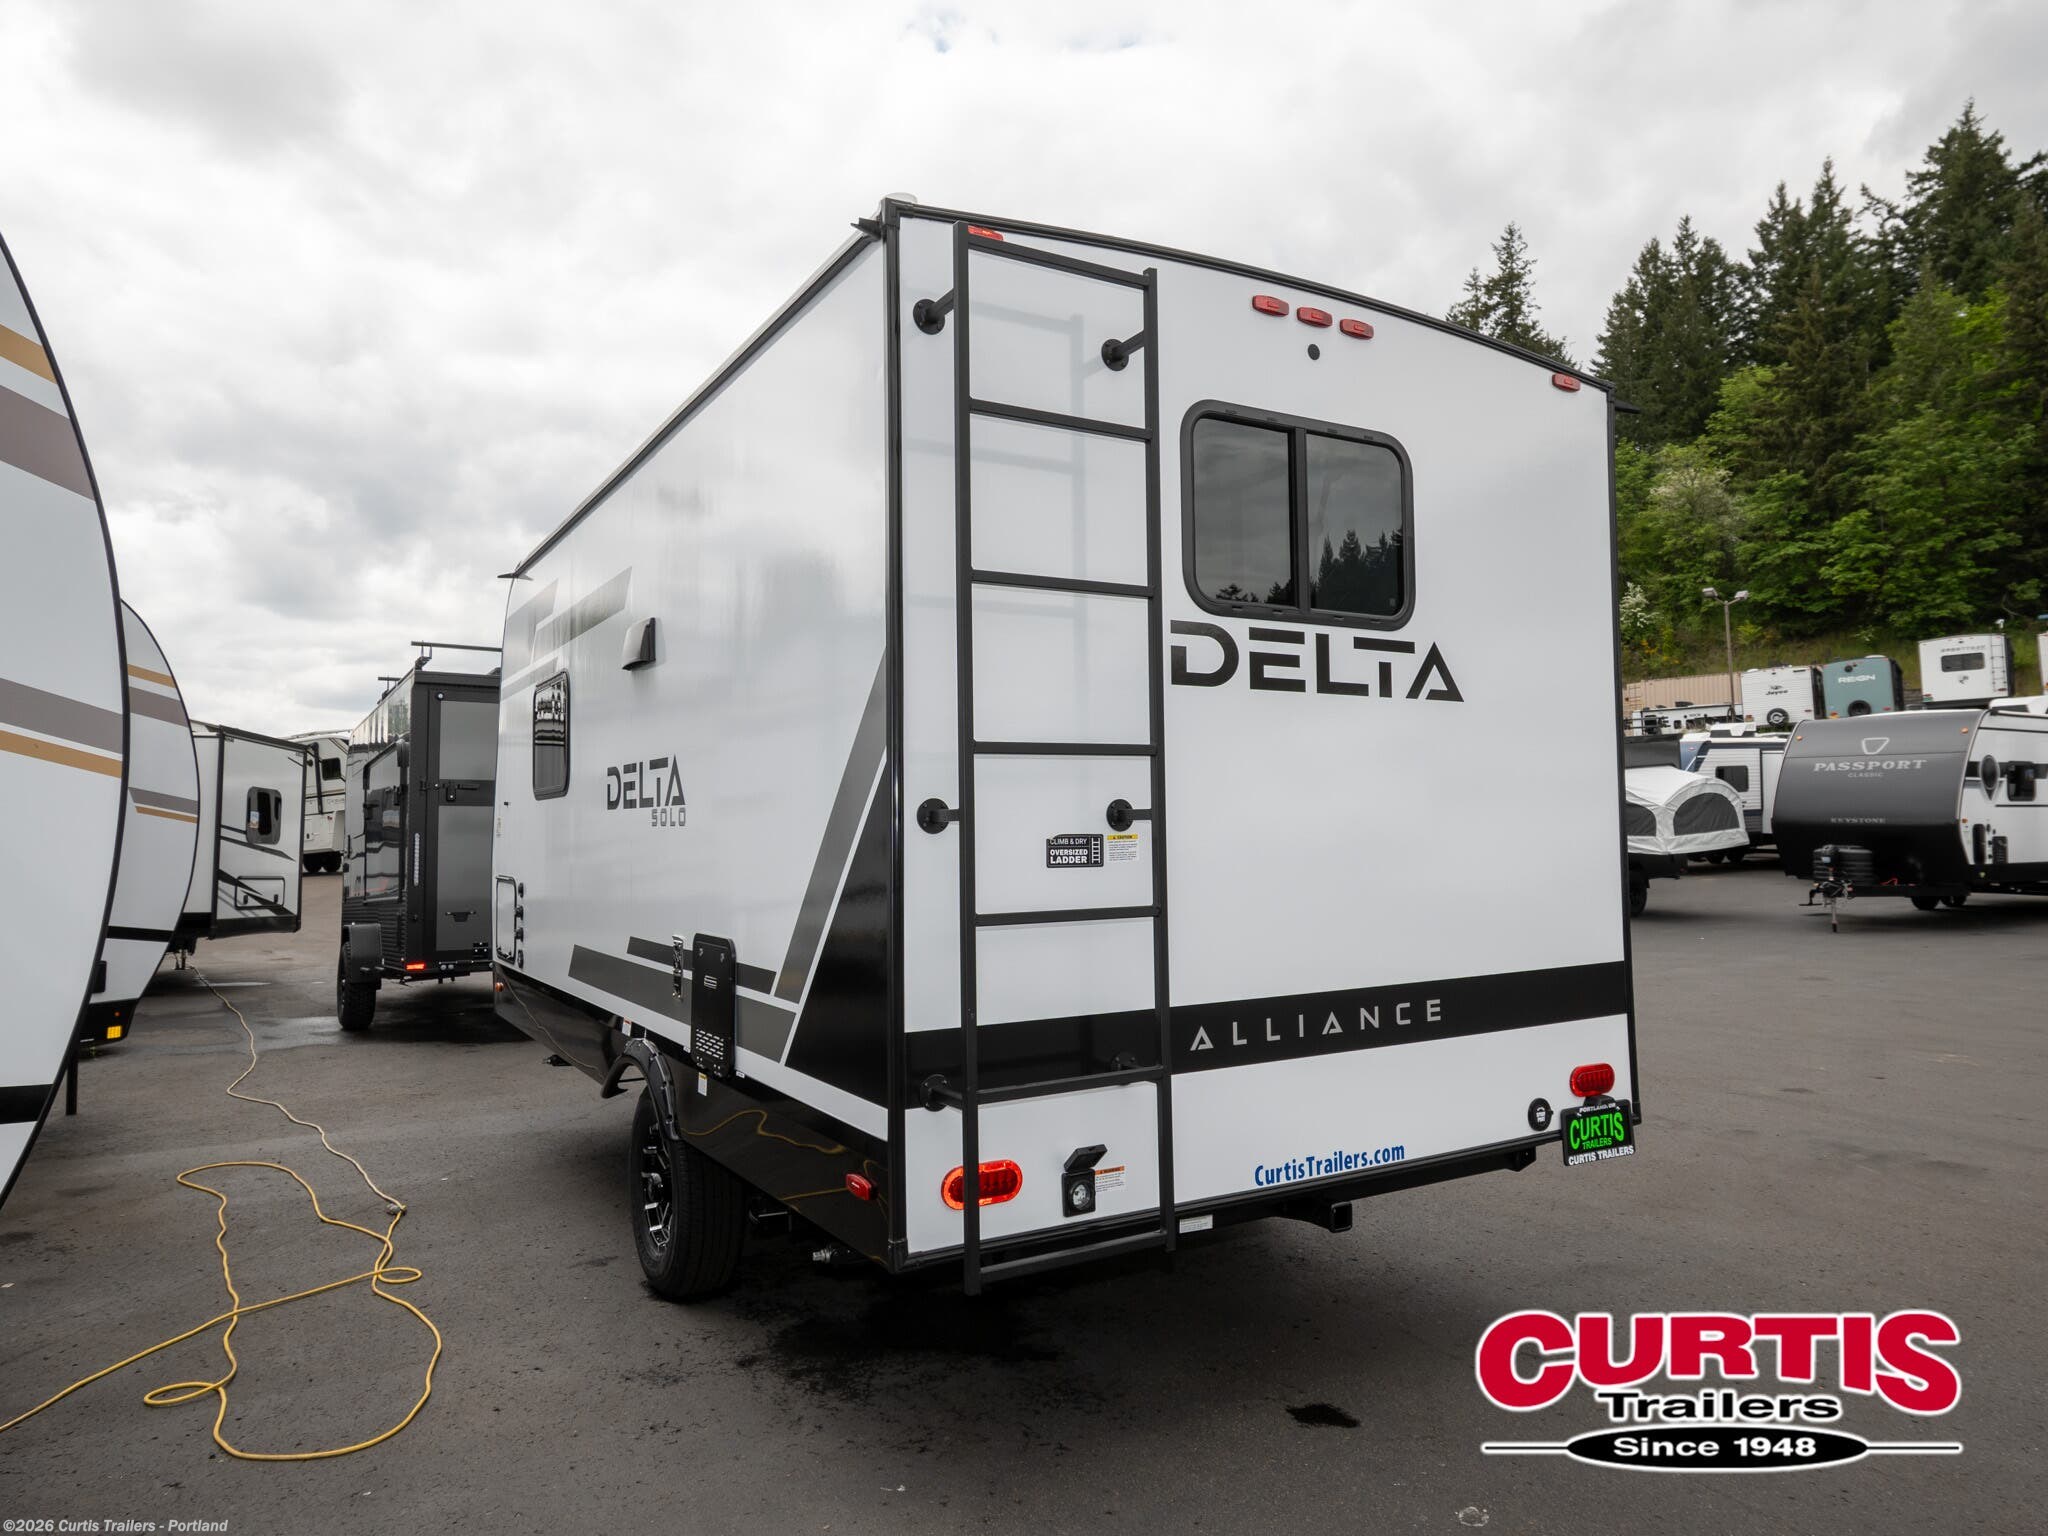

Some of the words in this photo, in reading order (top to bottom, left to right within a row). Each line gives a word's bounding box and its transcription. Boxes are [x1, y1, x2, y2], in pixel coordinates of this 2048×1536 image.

[1170, 619, 1465, 703] DELTA
[1838, 674, 1876, 683] REIGN
[1813, 759, 1928, 772] PASSPORT
[607, 753, 686, 811] DELTA
[651, 807, 686, 827] SOLO
[1050, 837, 1069, 845] CLIMB
[1076, 836, 1088, 845] DRY
[1050, 848, 1088, 856] OVERSIZED
[1050, 856, 1088, 864] LADDER
[1190, 999, 1441, 1051] ALLIANCE
[1570, 1112, 1625, 1150] CURTIS
[1582, 1137, 1613, 1150] TRAILERS
[1255, 1145, 1405, 1186] CurtisTrailers.com
[1568, 1151, 1597, 1166] CURTIS
[1596, 1145, 1634, 1160] TRAILERS
